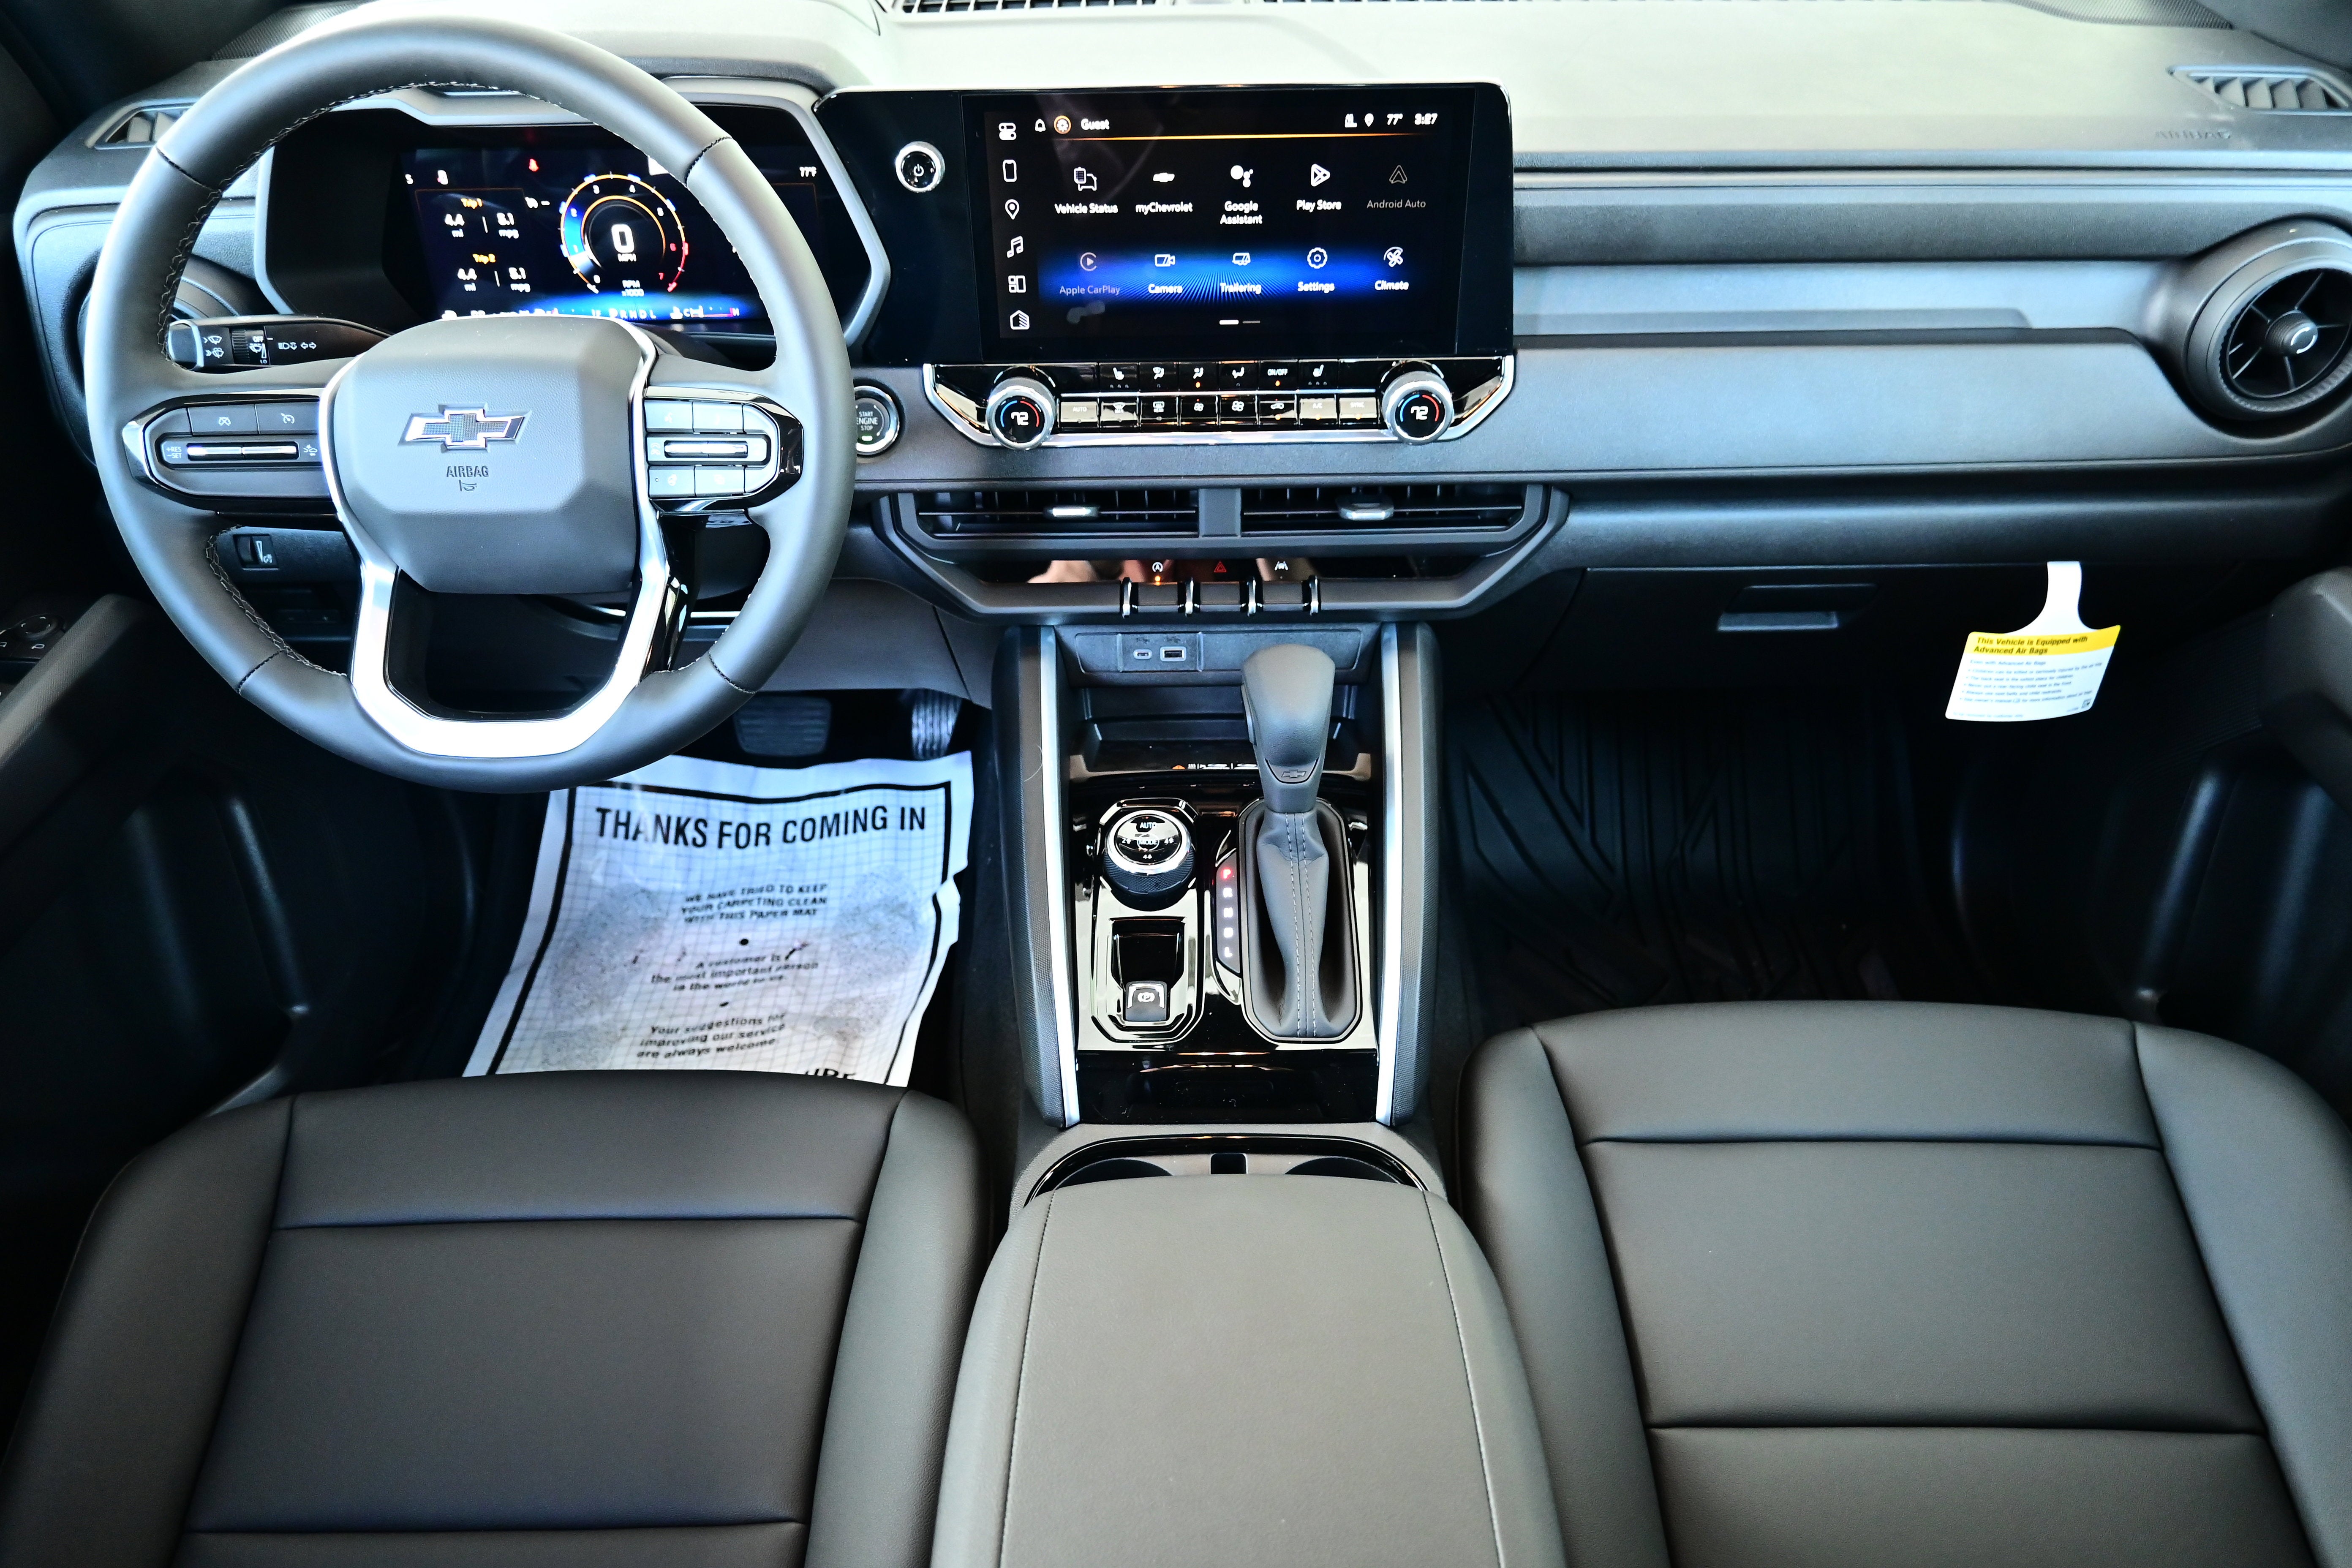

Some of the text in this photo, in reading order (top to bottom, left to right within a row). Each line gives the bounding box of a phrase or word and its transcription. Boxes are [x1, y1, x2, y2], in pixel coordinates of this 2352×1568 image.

[1081, 118, 1110, 131] Guest
[1054, 203, 1119, 214] Vehicle Status
[1135, 201, 1193, 215] myChevrolet
[1224, 200, 1259, 214] Google
[1296, 199, 1342, 212] Play Store
[1367, 199, 1426, 209] Android Auto
[1220, 214, 1263, 225] Assistant
[611, 223, 635, 253] 0
[1059, 285, 1120, 297] Apple CarPlay
[1148, 283, 1183, 294] Camera
[1219, 283, 1262, 294] Trailering
[1297, 281, 1335, 294] Settings
[1374, 280, 1409, 291] Climate
[1011, 411, 1029, 426] 72
[1410, 406, 1429, 420] 72
[446, 465, 489, 478] AIRBAG
[1977, 637, 1993, 645] This
[2027, 638, 2034, 646] is
[2036, 637, 2070, 646] Equipped
[1974, 646, 2014, 654] Advanced
[2029, 647, 2048, 656] Bags
[596, 806, 925, 849] THANKS FOR COMING IN
[1223, 868, 1232, 879] P
[779, 884, 794, 894] TO
[1224, 946, 1233, 958] L
